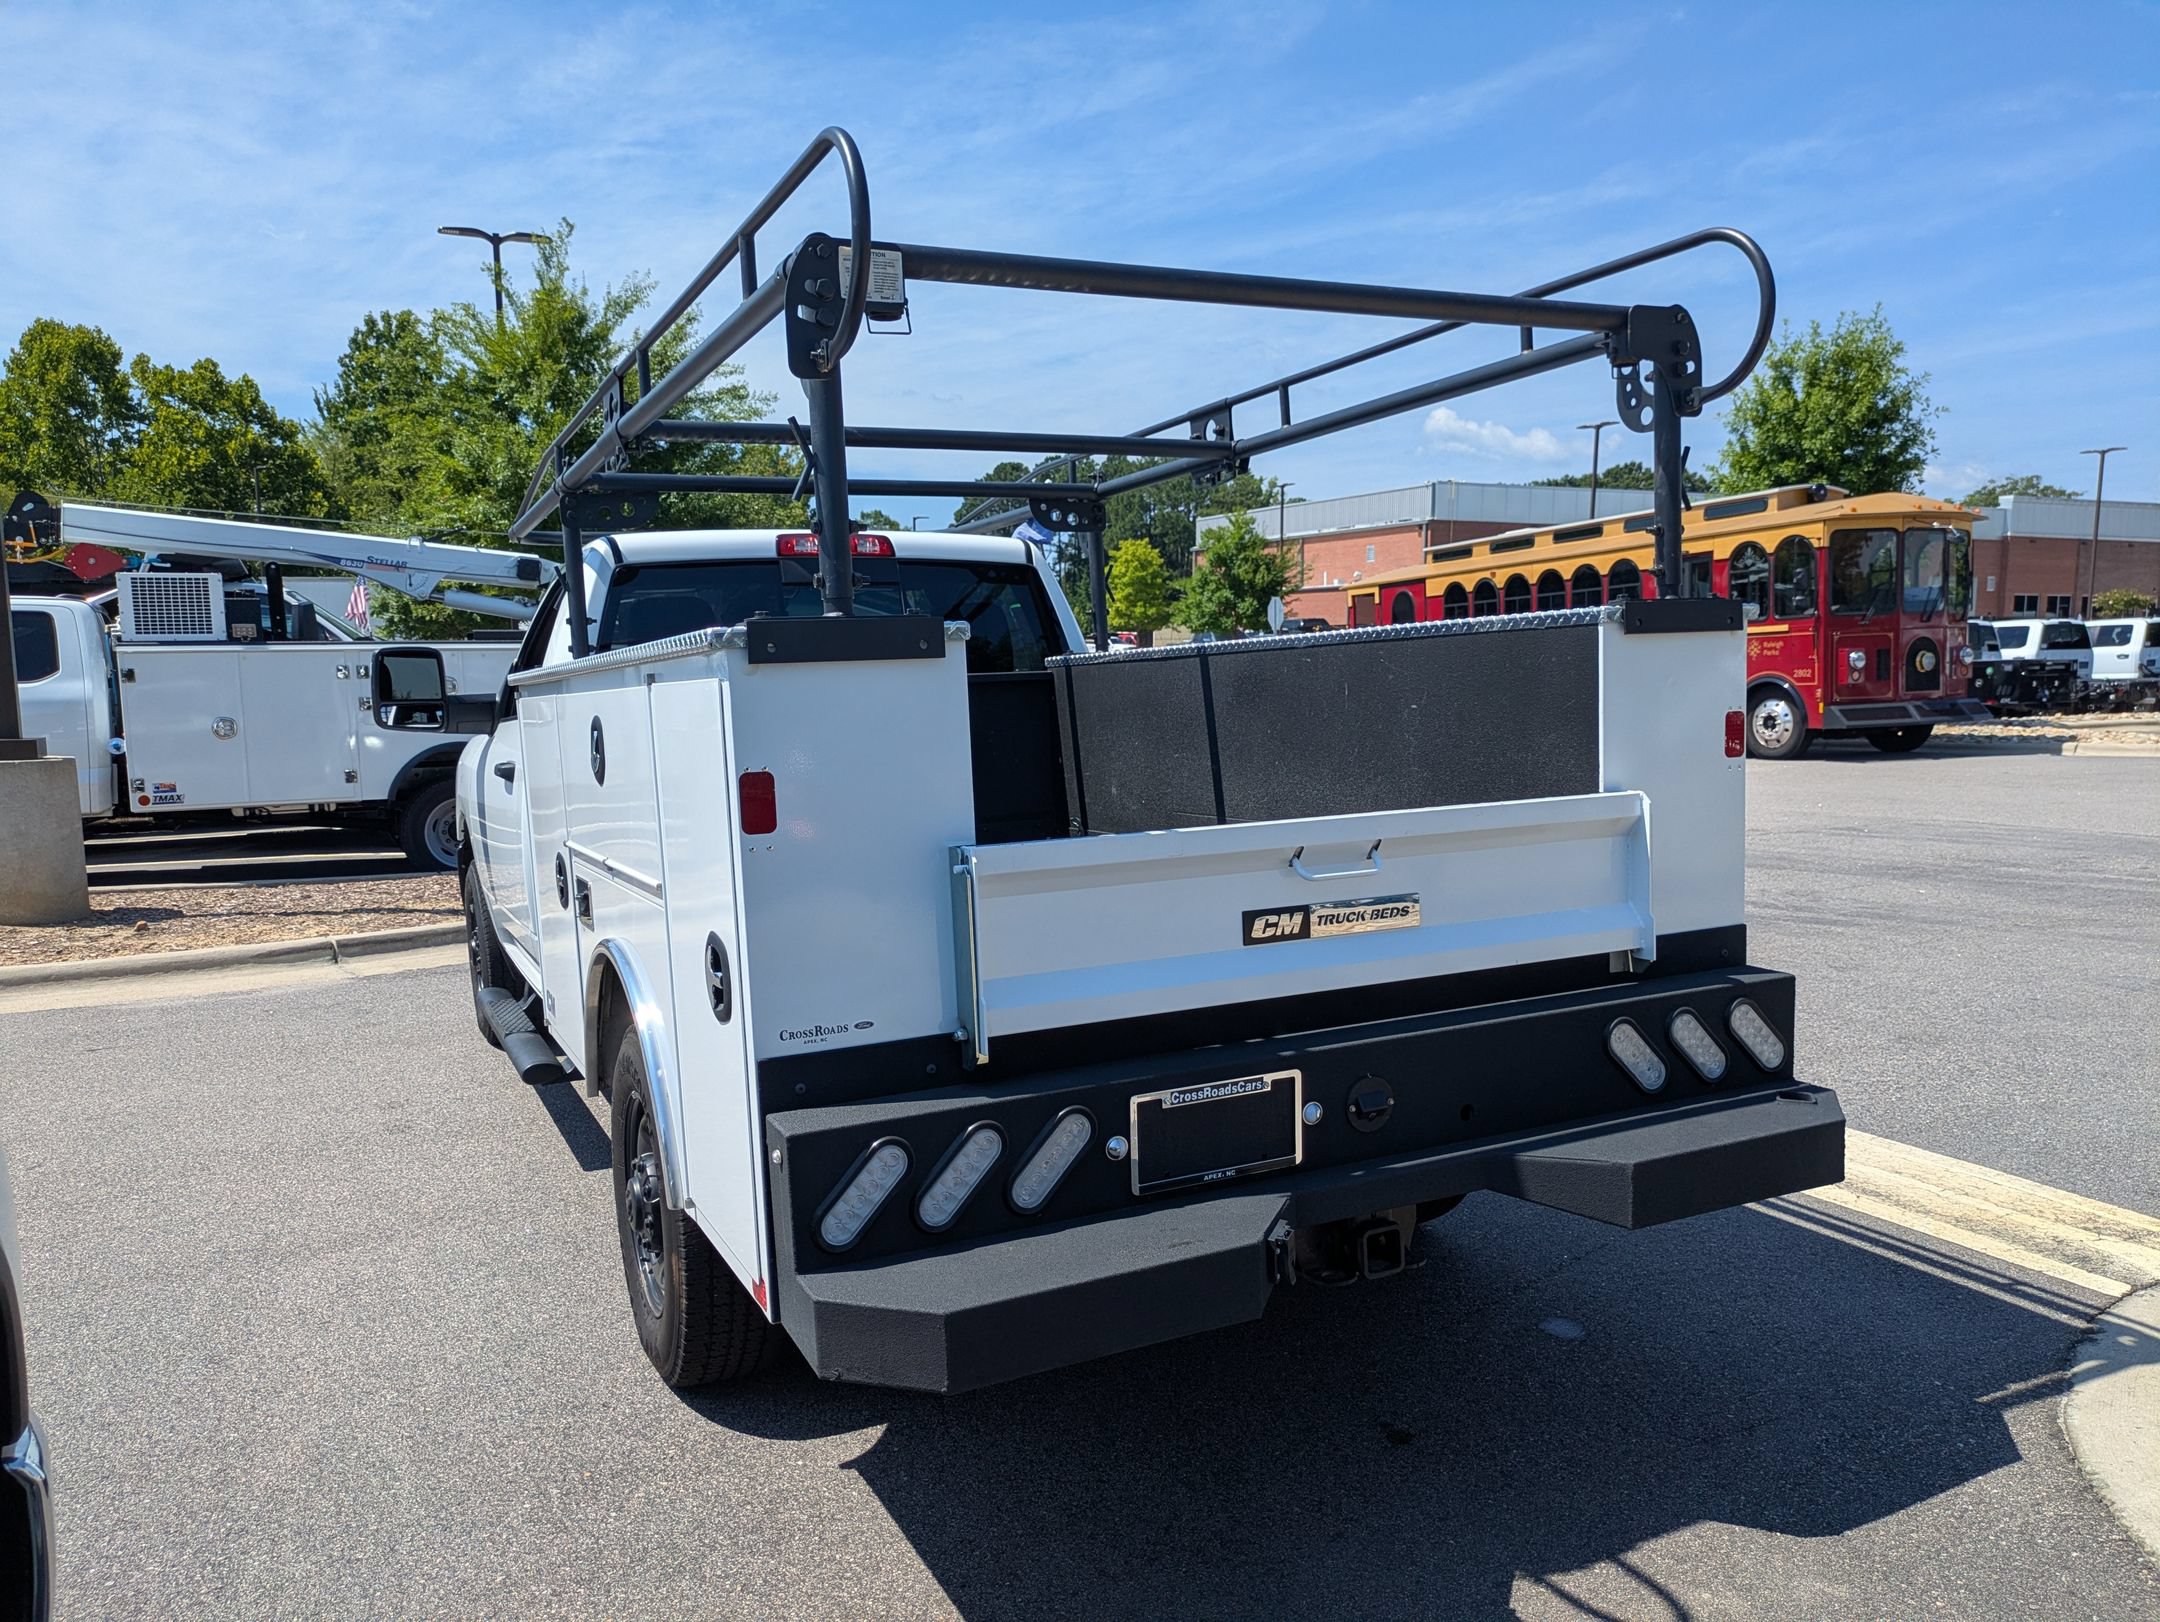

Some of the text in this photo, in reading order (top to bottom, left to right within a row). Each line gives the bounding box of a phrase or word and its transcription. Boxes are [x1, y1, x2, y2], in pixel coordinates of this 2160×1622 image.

[366, 555, 408, 571] STELLAR
[152, 793, 183, 802] TMAX
[1250, 905, 1410, 939] CM TRUCK BEDS
[779, 1023, 849, 1042] CROSSROADS
[1170, 1079, 1263, 1104] CrossRoadsCars
[1225, 1169, 1236, 1177] NC
